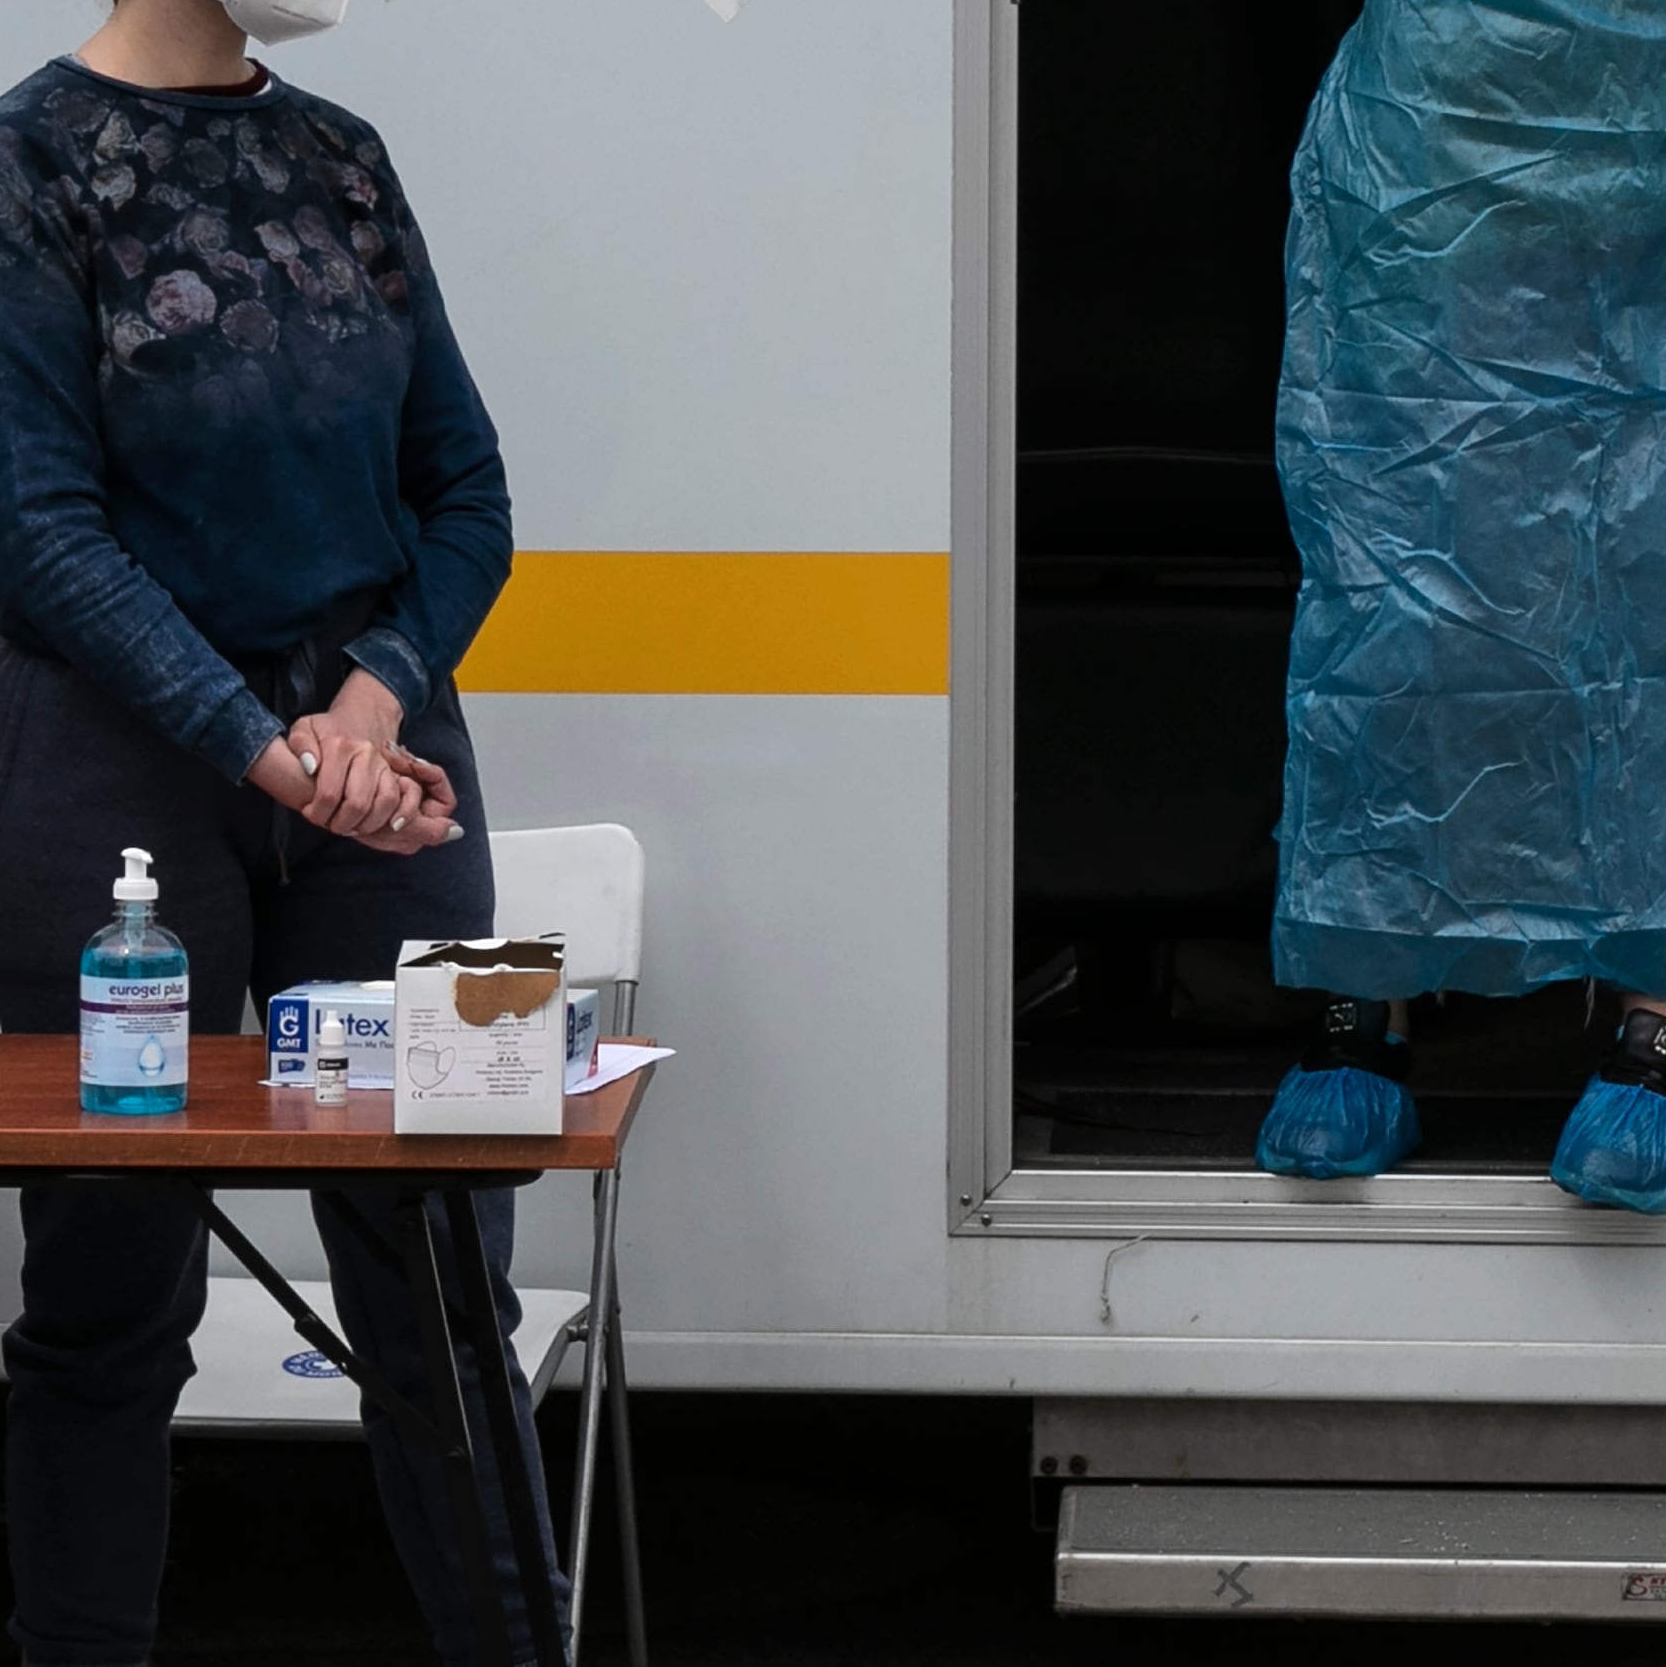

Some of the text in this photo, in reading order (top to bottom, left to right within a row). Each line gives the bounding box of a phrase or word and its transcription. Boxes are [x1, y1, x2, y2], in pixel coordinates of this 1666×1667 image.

[109, 983, 161, 998] eurogel
[315, 1009, 390, 1037] Ltex
[277, 1038, 302, 1048] GMT
